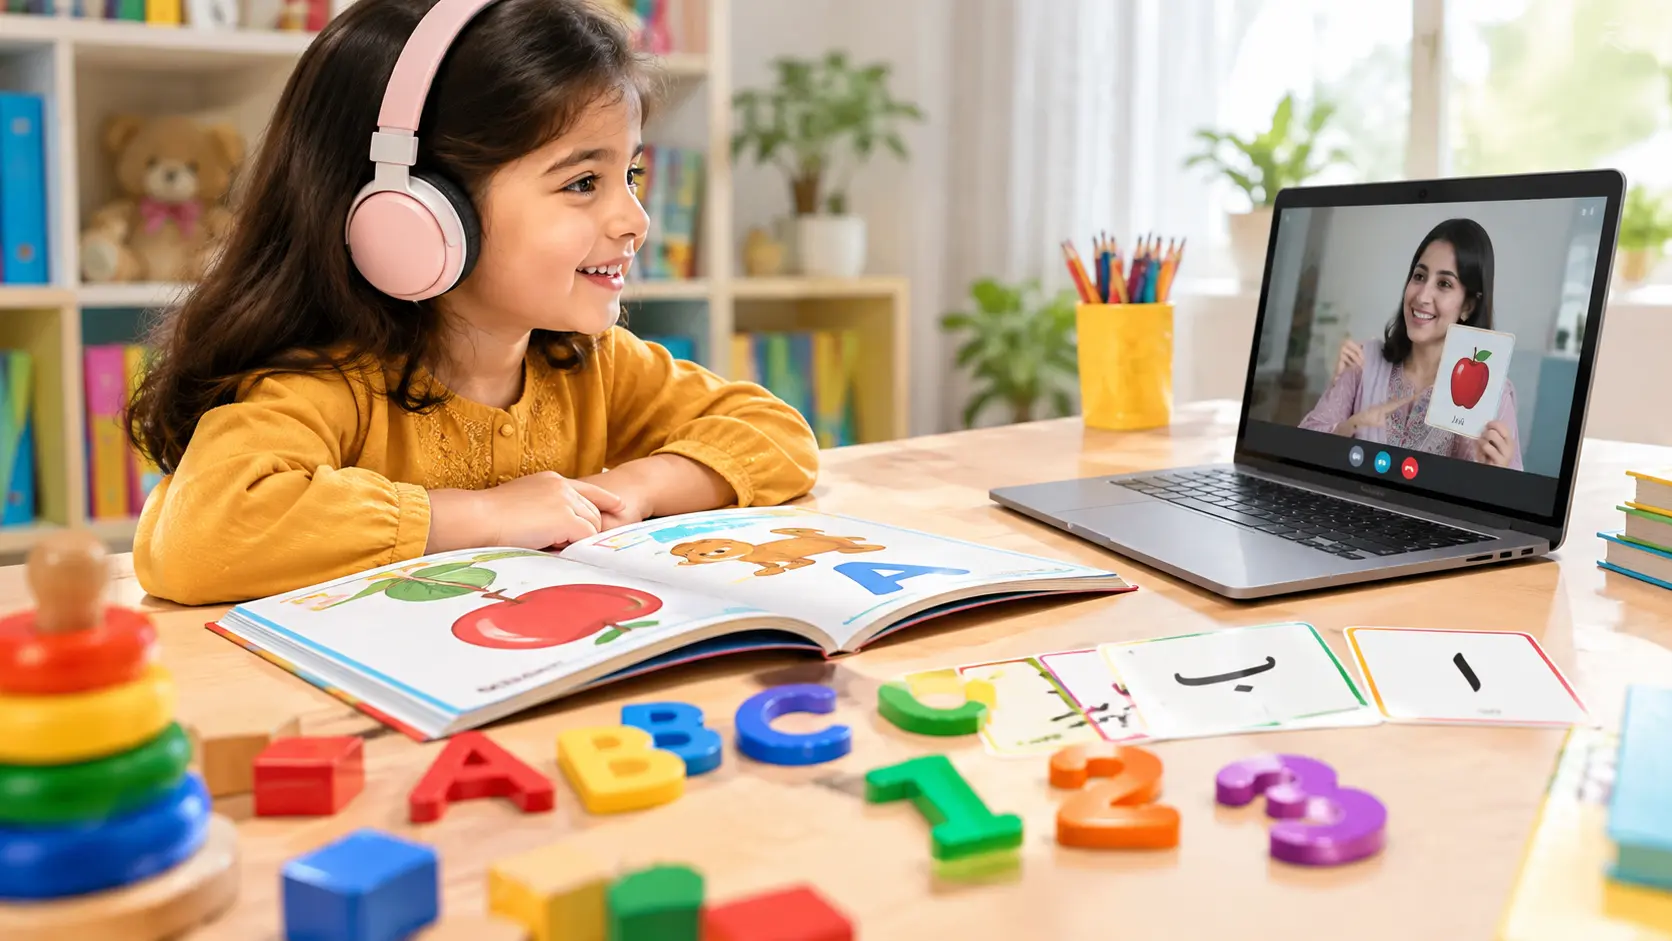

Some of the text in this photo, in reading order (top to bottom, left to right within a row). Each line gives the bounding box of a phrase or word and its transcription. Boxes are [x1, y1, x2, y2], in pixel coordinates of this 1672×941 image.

[833, 562, 970, 595] A
[1174, 656, 1276, 692] ب
[620, 702, 723, 776] B
[735, 683, 853, 765] C
[408, 731, 556, 823] A
[557, 726, 686, 814] B
[864, 745, 1387, 865] 1 2 3
